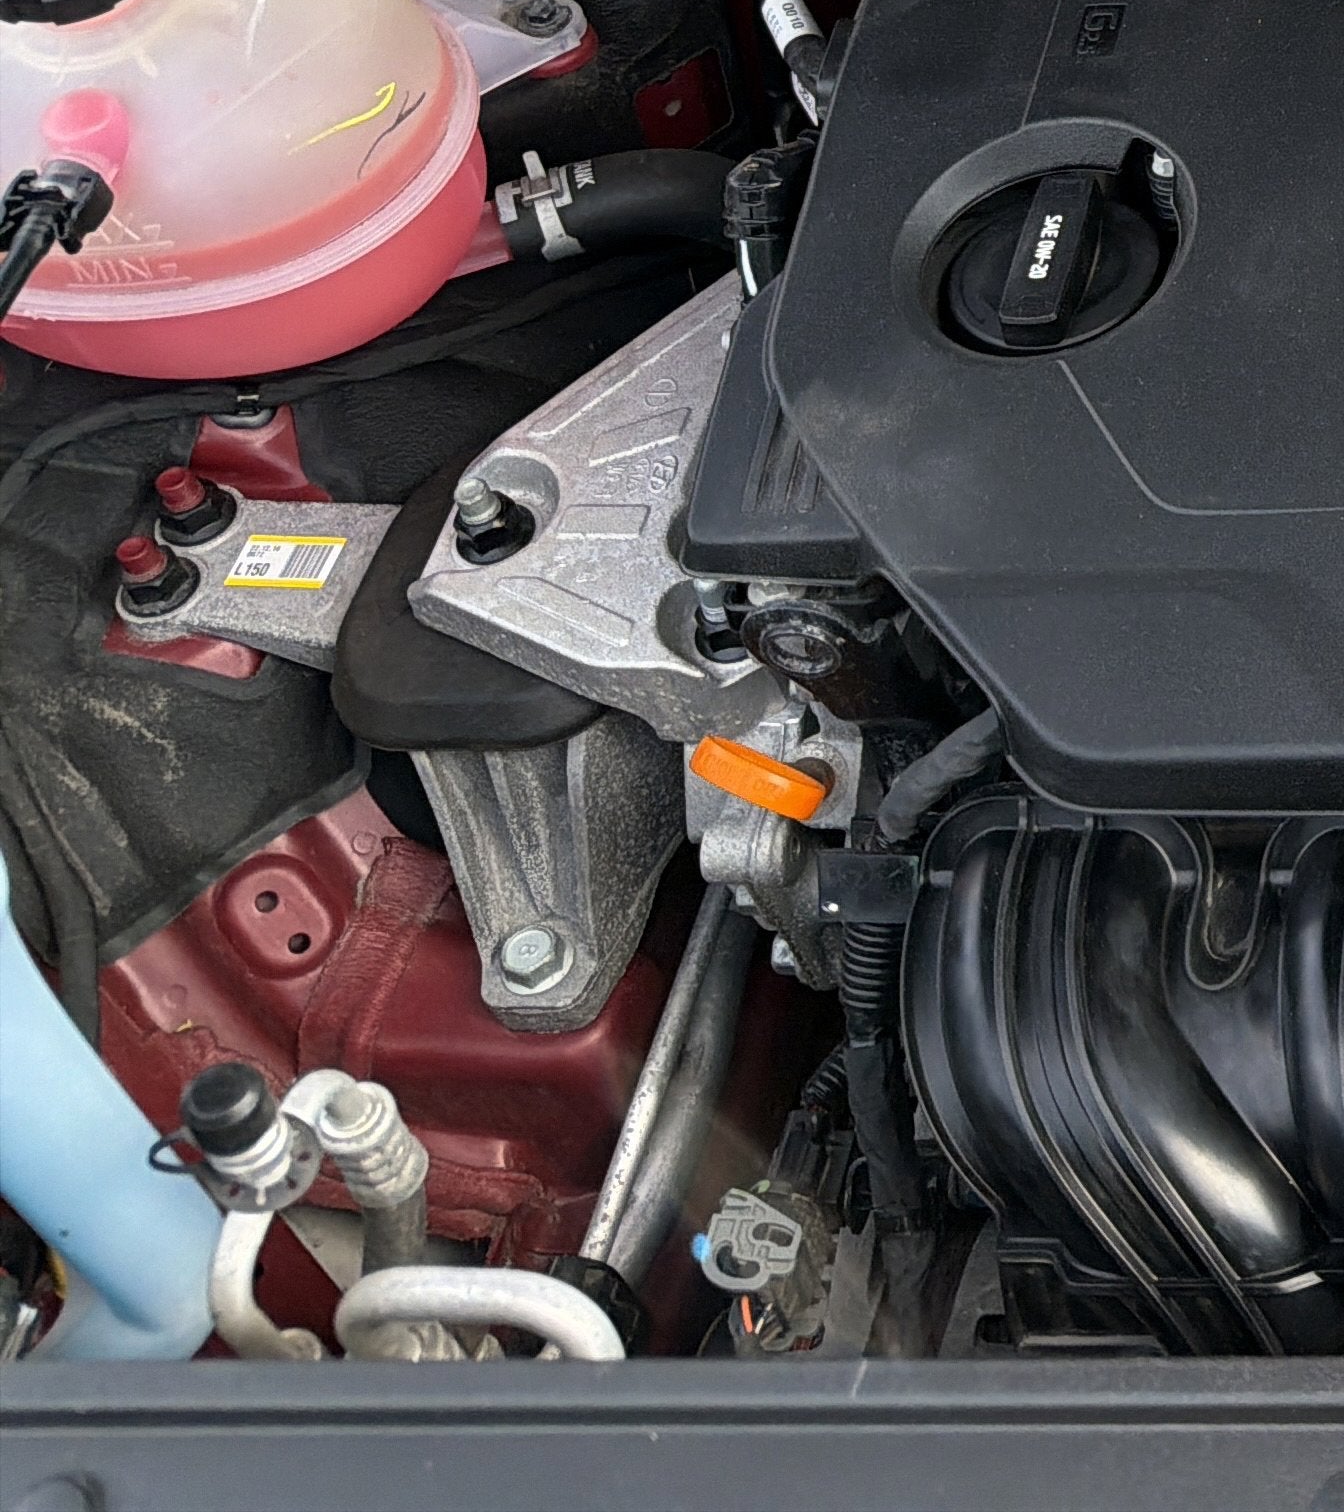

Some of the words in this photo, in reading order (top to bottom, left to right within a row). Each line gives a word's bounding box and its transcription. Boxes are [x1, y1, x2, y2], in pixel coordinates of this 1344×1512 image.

[1039, 214, 1063, 239] SAE
[70, 256, 154, 285] MIN
[1027, 239, 1056, 280] 0W-20
[234, 562, 271, 577] L150
